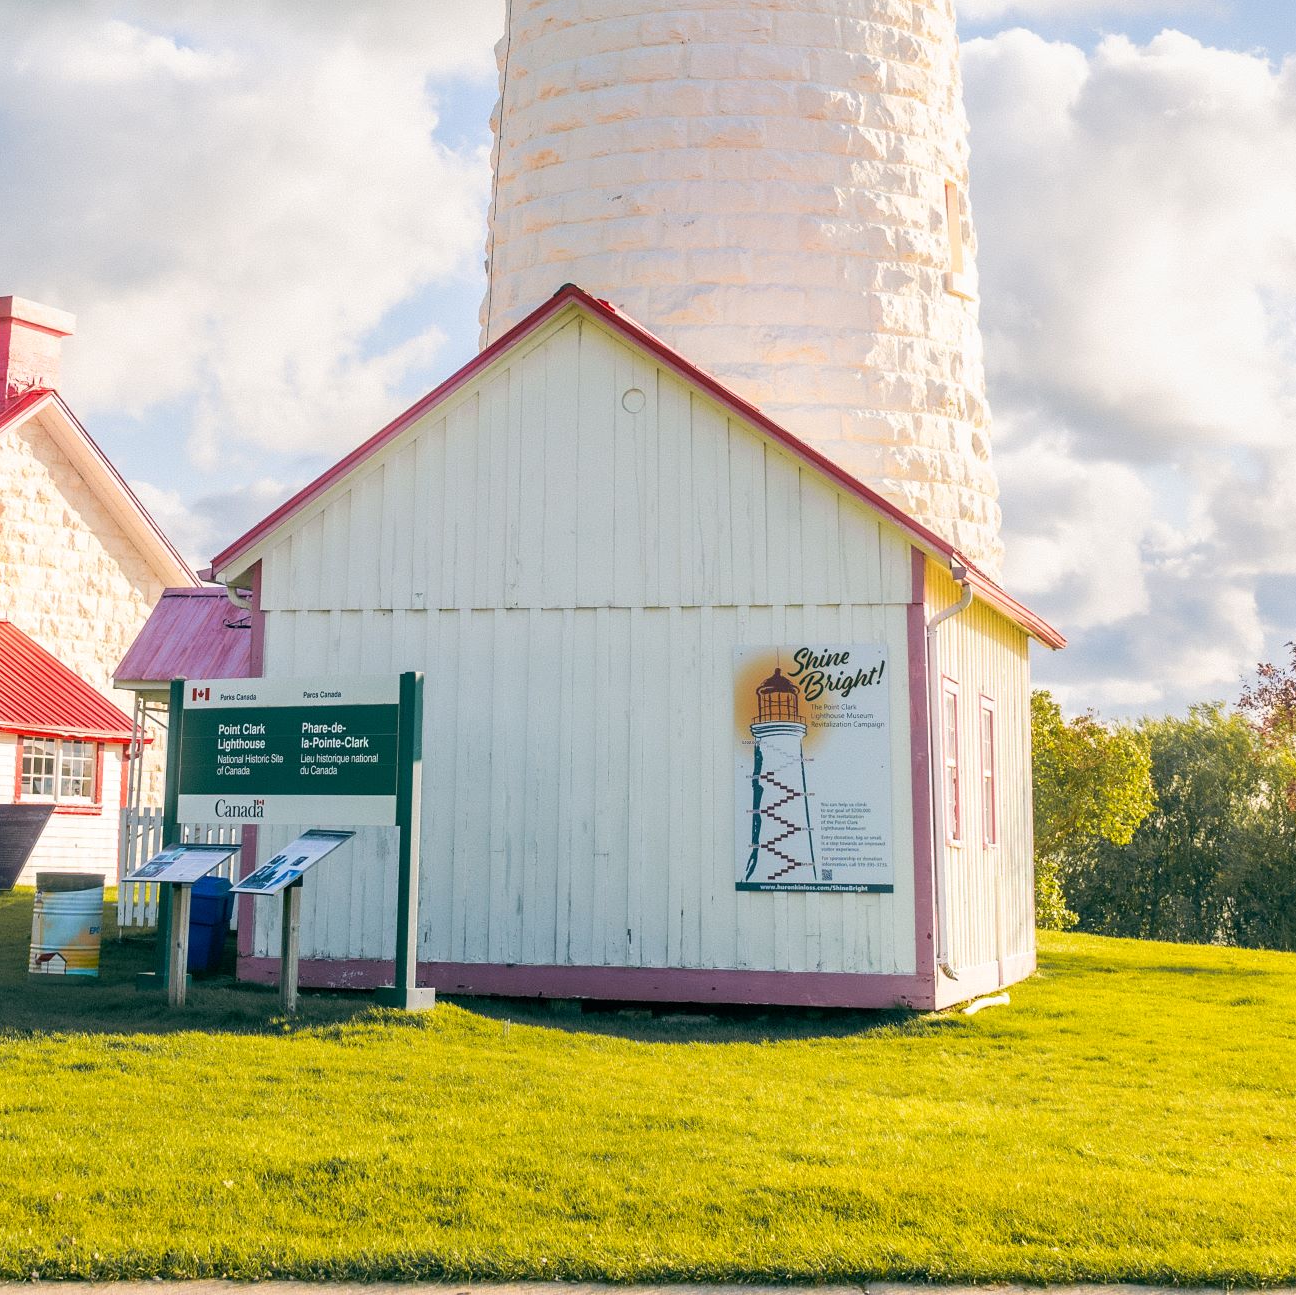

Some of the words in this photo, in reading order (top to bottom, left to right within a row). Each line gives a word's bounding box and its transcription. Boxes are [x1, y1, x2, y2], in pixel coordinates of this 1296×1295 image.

[787, 647, 850, 677] Shine
[799, 660, 885, 701] Bright!
[811, 712, 845, 720] Lighthouse
[218, 724, 241, 735] Point
[242, 723, 266, 735] Clark
[302, 722, 347, 734] Phare-de-
[853, 721, 885, 729] Campaign
[217, 738, 266, 752] Lighthouse
[301, 736, 369, 749] la-Pointe-Clark
[217, 754, 244, 764] National
[245, 754, 270, 764] Historic
[270, 753, 284, 764] Site
[300, 753, 315, 763] Lieu
[316, 753, 350, 765] historique
[350, 753, 379, 763] national
[216, 766, 224, 775] of
[224, 766, 251, 775] Canada
[299, 765, 310, 775] du
[310, 765, 338, 775] Canada
[215, 798, 264, 818] Canada
[759, 884, 868, 892] www.huronkinloss.com/ShineBright
